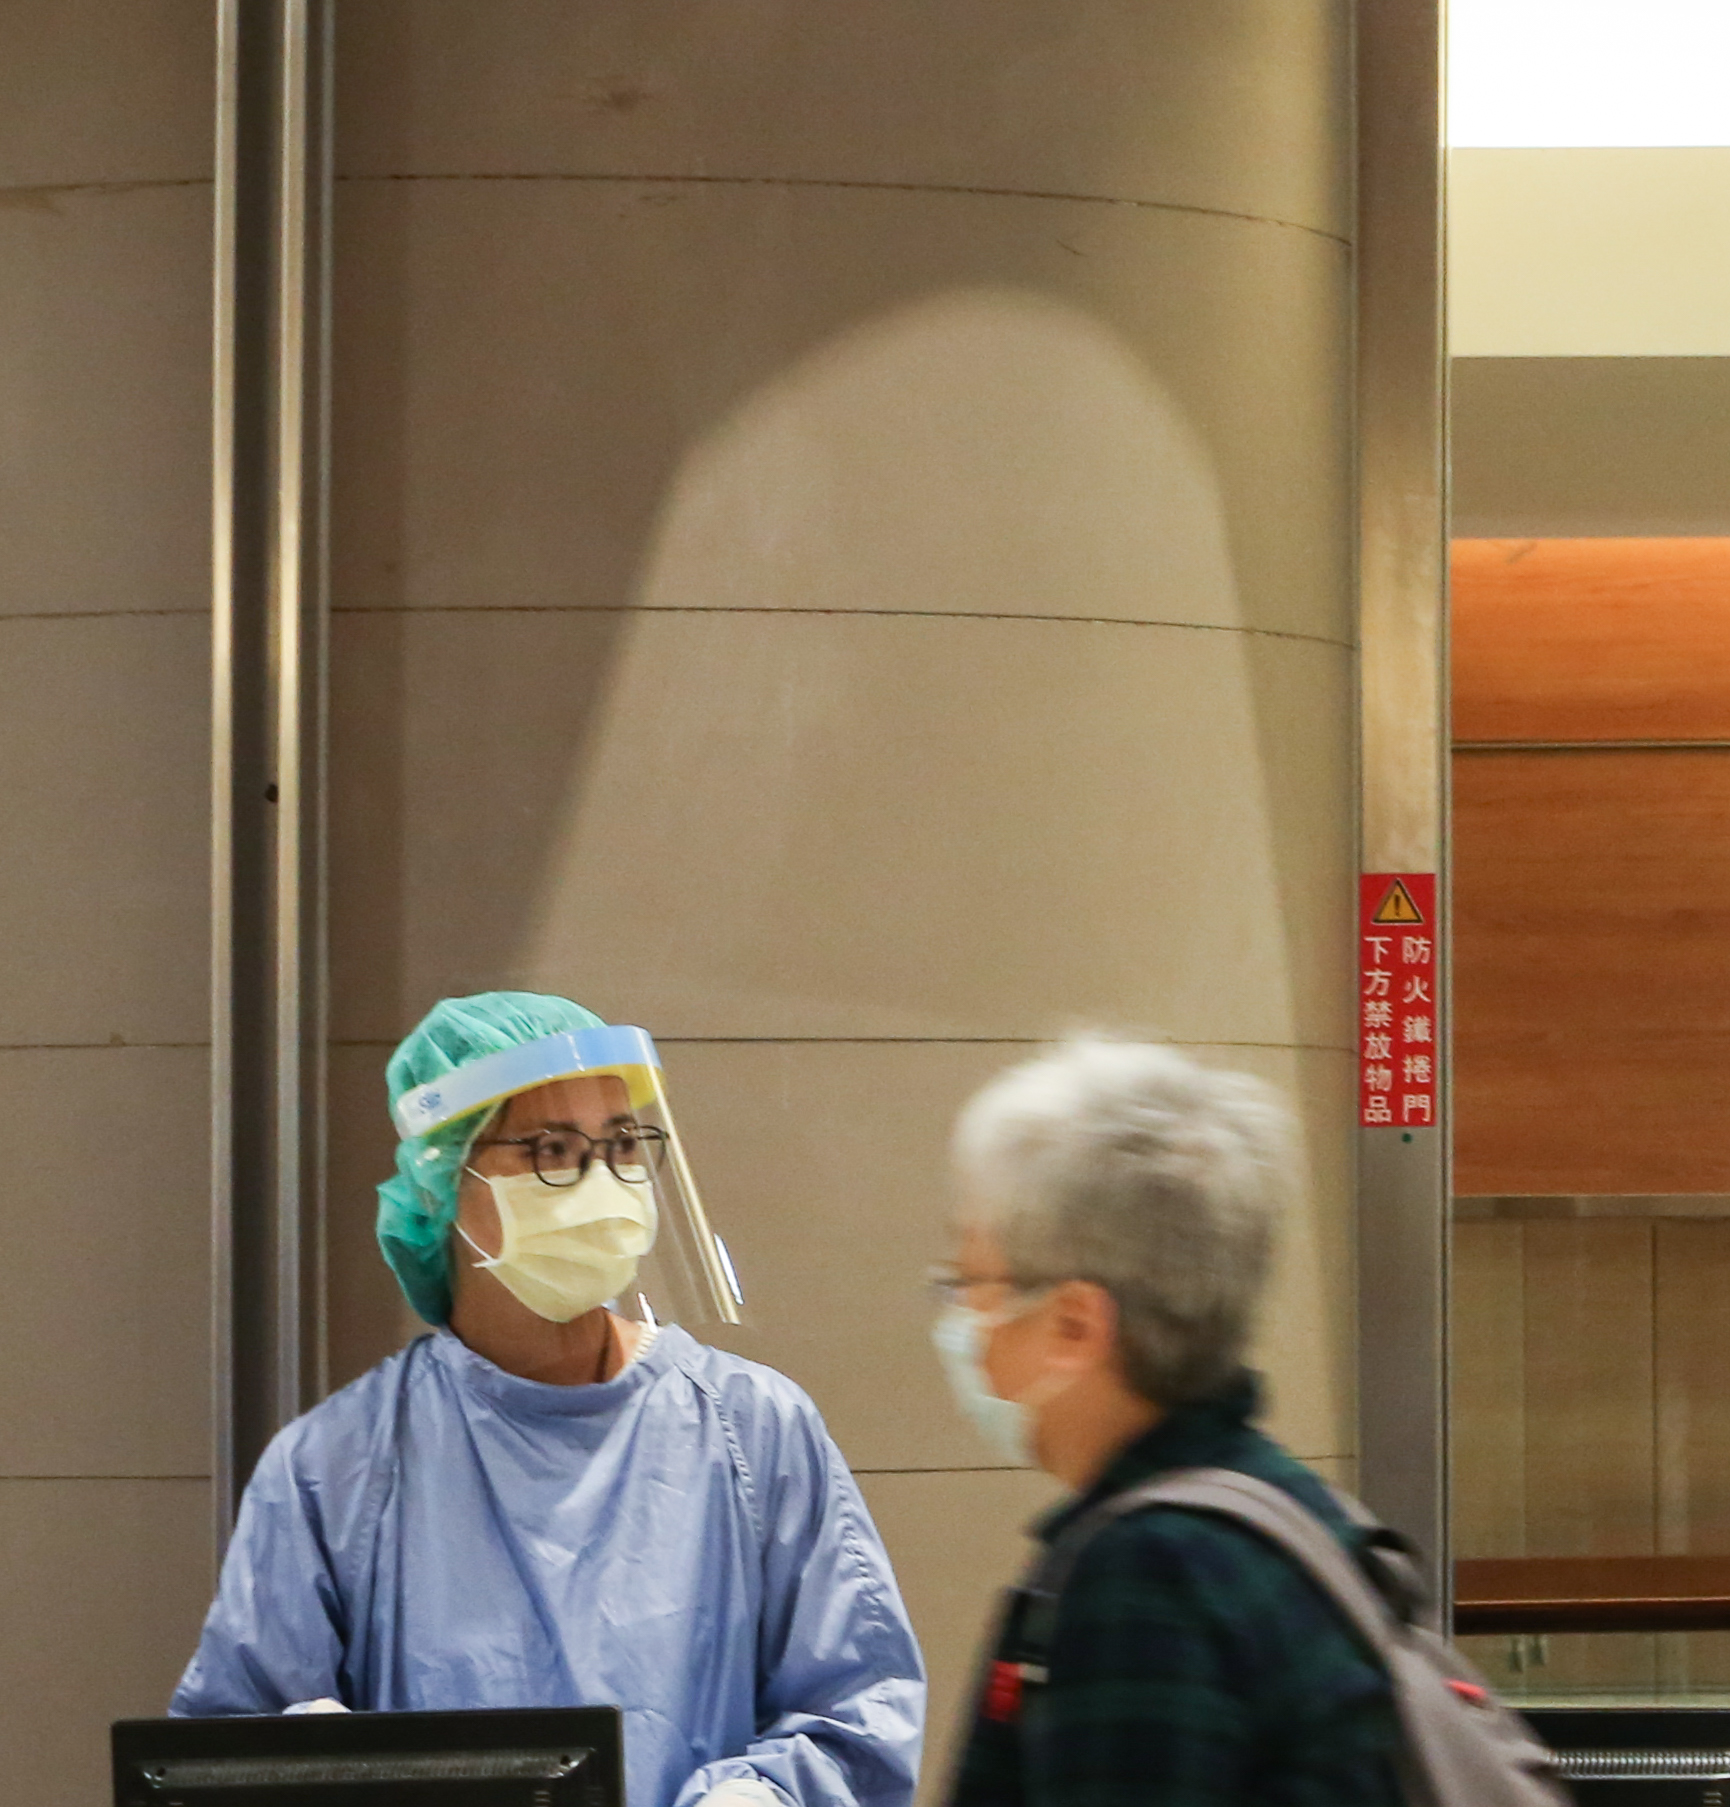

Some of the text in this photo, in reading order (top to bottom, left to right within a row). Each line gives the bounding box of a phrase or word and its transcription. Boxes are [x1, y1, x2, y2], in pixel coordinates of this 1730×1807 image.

[1363, 936, 1393, 1123] 下方禁放物品
[1402, 936, 1432, 1123] 防火鐵捲門
